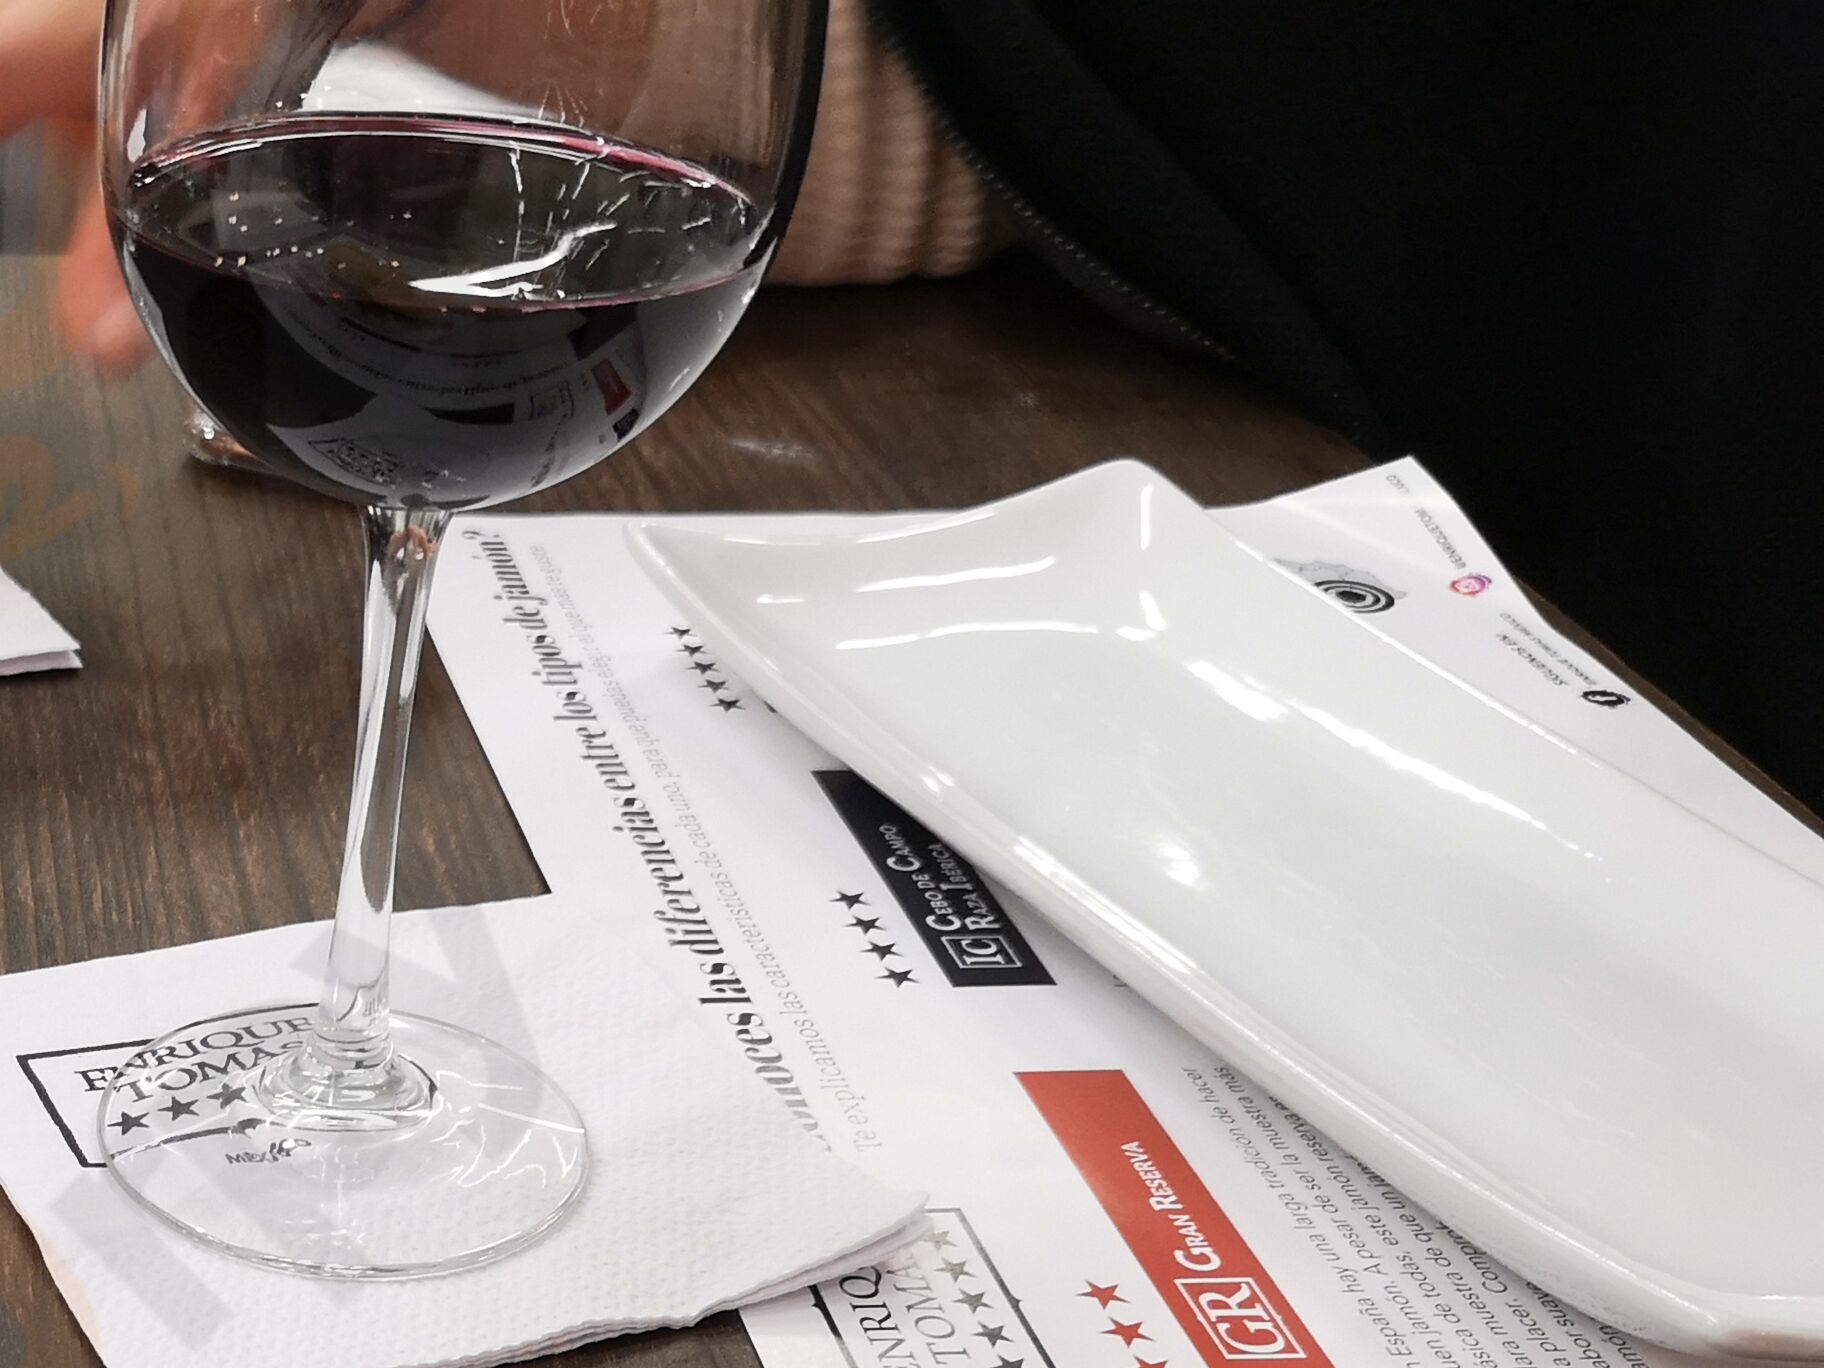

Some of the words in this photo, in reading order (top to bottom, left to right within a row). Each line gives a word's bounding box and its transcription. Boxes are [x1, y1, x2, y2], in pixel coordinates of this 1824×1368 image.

[461, 529, 549, 607] jamón?
[502, 605, 548, 629] de
[526, 634, 583, 685] tipos
[552, 690, 598, 721] los
[629, 724, 660, 749] que
[575, 726, 636, 791] entre
[643, 749, 680, 781] para
[674, 814, 711, 849] cada
[611, 796, 725, 956] diferencias
[693, 850, 723, 870] de
[960, 939, 1005, 966] IC
[698, 961, 753, 1006] las
[777, 990, 807, 1016] las
[793, 1017, 870, 1126] explicamos
[1182, 1066, 1220, 1104] hacer
[1212, 1065, 1245, 1094] más
[1210, 1104, 1237, 1126] de
[1237, 1094, 1290, 1152] muestra
[1283, 1112, 1335, 1164] reserva
[1228, 1126, 1286, 1191] tradición
[1279, 1152, 1303, 1166] la
[1294, 1168, 1322, 1193] ser
[1325, 1163, 1381, 1213] jamón
[1277, 1192, 1317, 1230] larga
[1310, 1192, 1339, 1215] de
[1379, 1190, 1407, 1211] un
[1329, 1216, 1382, 1260] pesar
[1364, 1212, 1400, 1247] este
[1398, 1212, 1433, 1244] que
[1308, 1233, 1341, 1263] una
[1425, 1246, 1452, 1269] de
[1331, 1264, 1366, 1294] hay
[1362, 1262, 1389, 1277] A
[1395, 1250, 1442, 1300] todas,
[1198, 1281, 1287, 1354] GR
[1383, 1280, 1444, 1336] jamón.
[1431, 1302, 1462, 1325] de
[1446, 1271, 1508, 1337] muestra
[1525, 1280, 1575, 1328] suave
[1357, 1298, 1413, 1358] España
[1504, 1297, 1568, 1353] placer.
